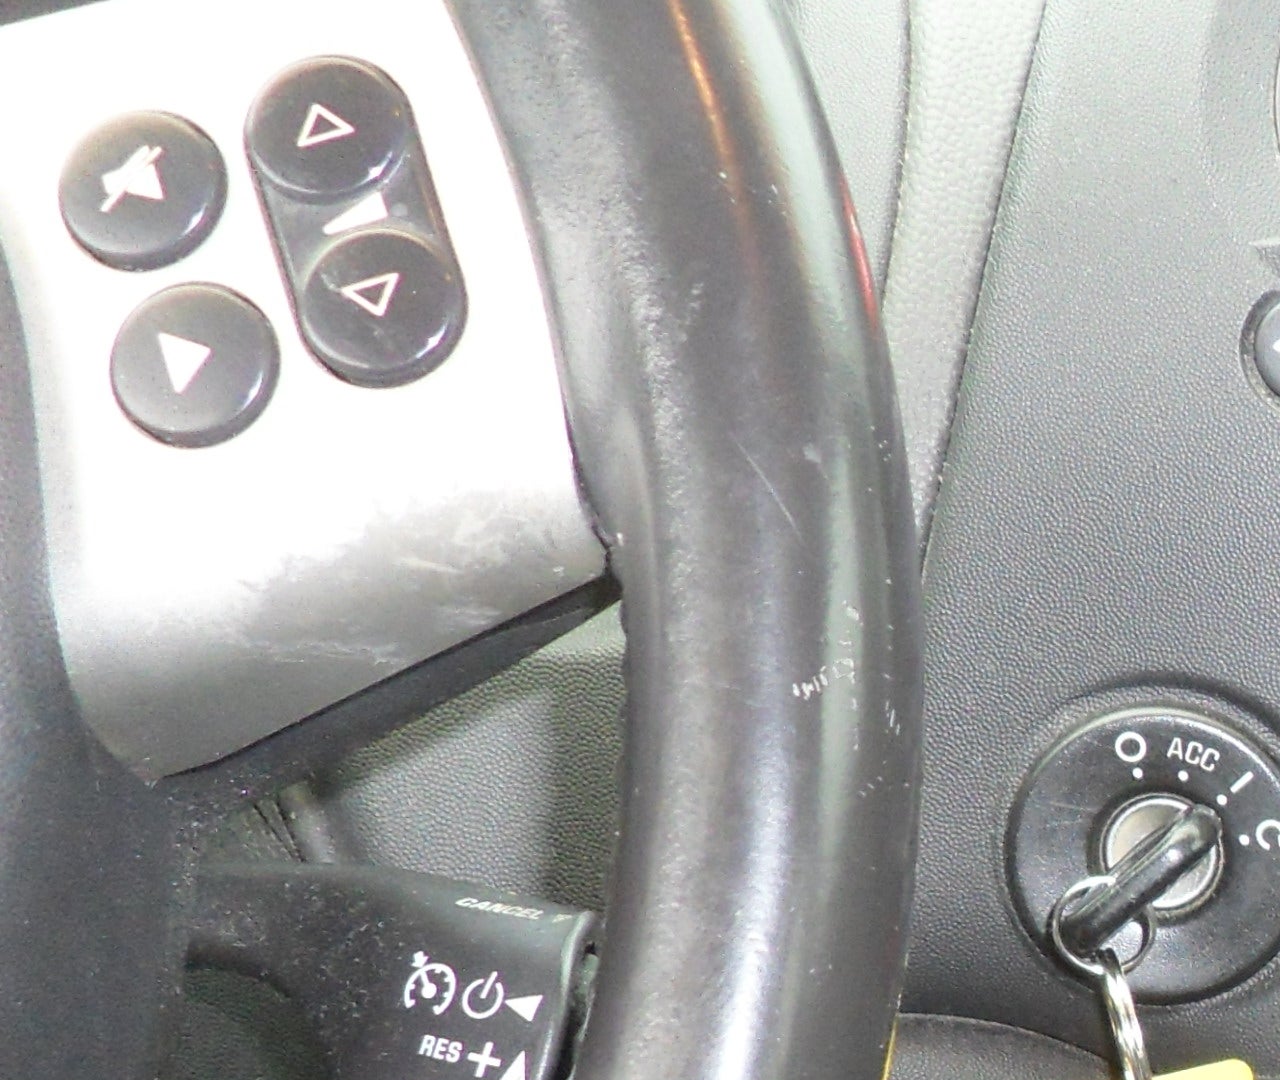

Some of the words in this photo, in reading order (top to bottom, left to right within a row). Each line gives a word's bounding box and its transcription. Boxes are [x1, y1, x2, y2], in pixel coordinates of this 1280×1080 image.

[1166, 736, 1221, 772] ACC
[455, 896, 544, 920] CANCEL
[418, 1034, 463, 1063] RES
